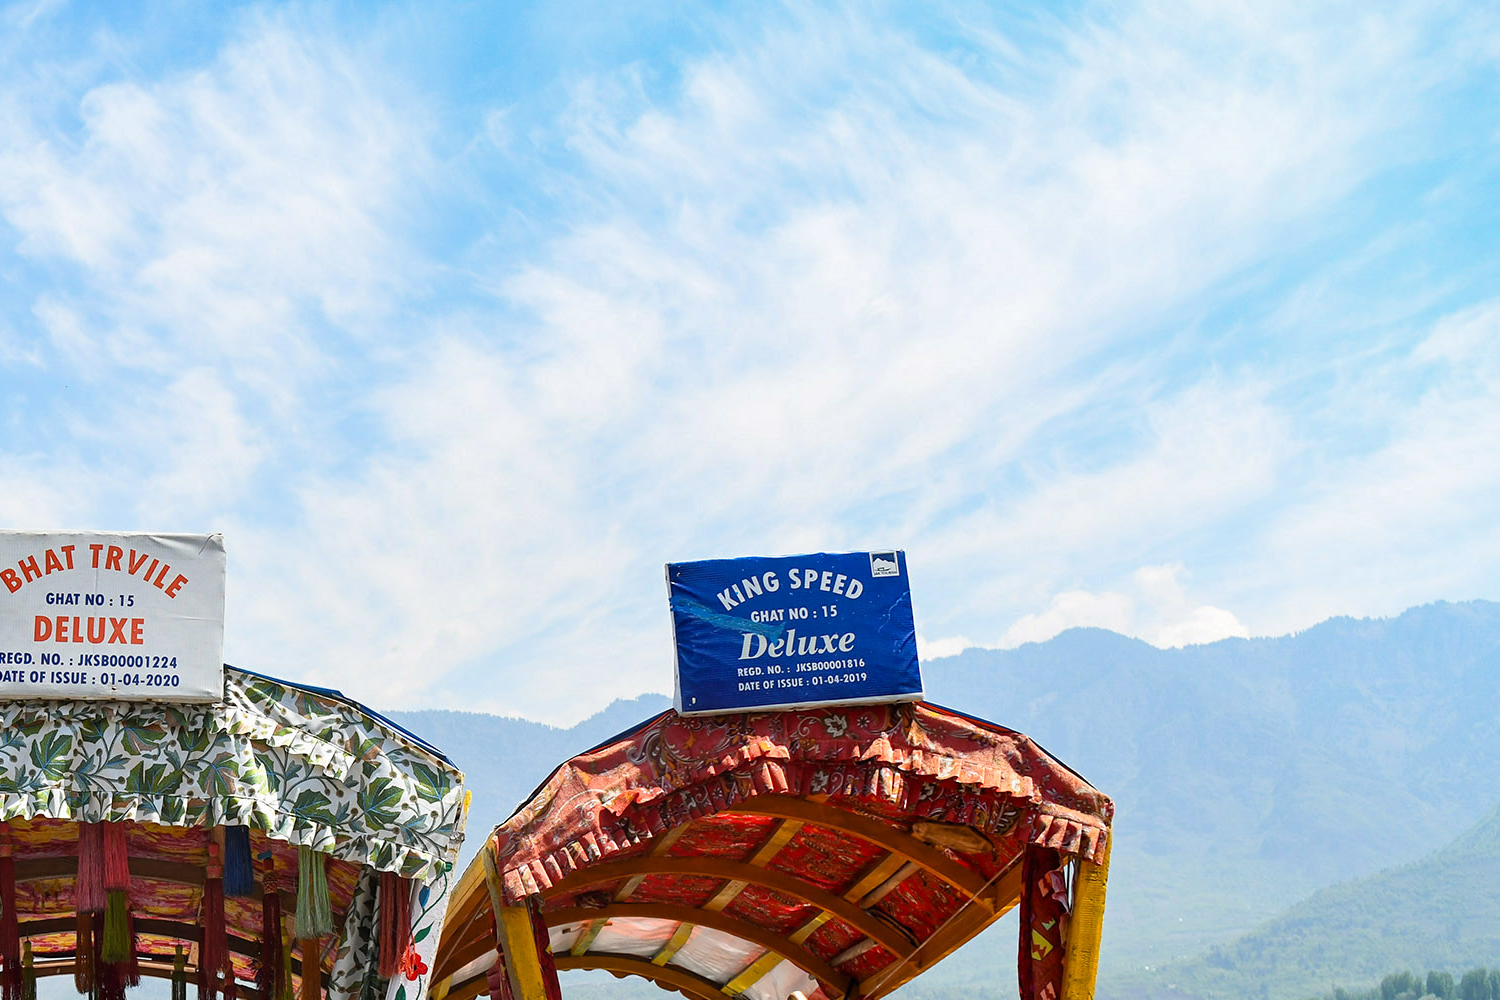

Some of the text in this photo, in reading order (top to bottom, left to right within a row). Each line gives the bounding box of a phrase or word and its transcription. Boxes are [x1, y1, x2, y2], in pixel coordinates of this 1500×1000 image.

[89, 544, 188, 599] TRVILE
[717, 568, 863, 611] KING SPEED
[45, 592, 81, 605] GHAT
[85, 594, 105, 606] NO
[119, 595, 135, 607] 15
[751, 609, 785, 623] GHAT
[789, 607, 809, 620] NO
[821, 605, 838, 618] 15
[34, 615, 145, 645] DELUXE
[738, 629, 856, 660] Deluxe
[41, 654, 64, 666] NO.
[78, 654, 178, 669] JKSB00001224
[737, 665, 764, 677] REGD.
[767, 664, 785, 675] NO.
[796, 658, 865, 673] JKSB00001816
[30, 671, 46, 683] OF
[51, 672, 87, 685] ISSUE
[101, 673, 180, 687] 01-04-2020
[738, 680, 760, 692] DATE
[763, 680, 775, 690] OF
[777, 678, 804, 689] ISSUE
[812, 673, 867, 686] 01-04-2019
